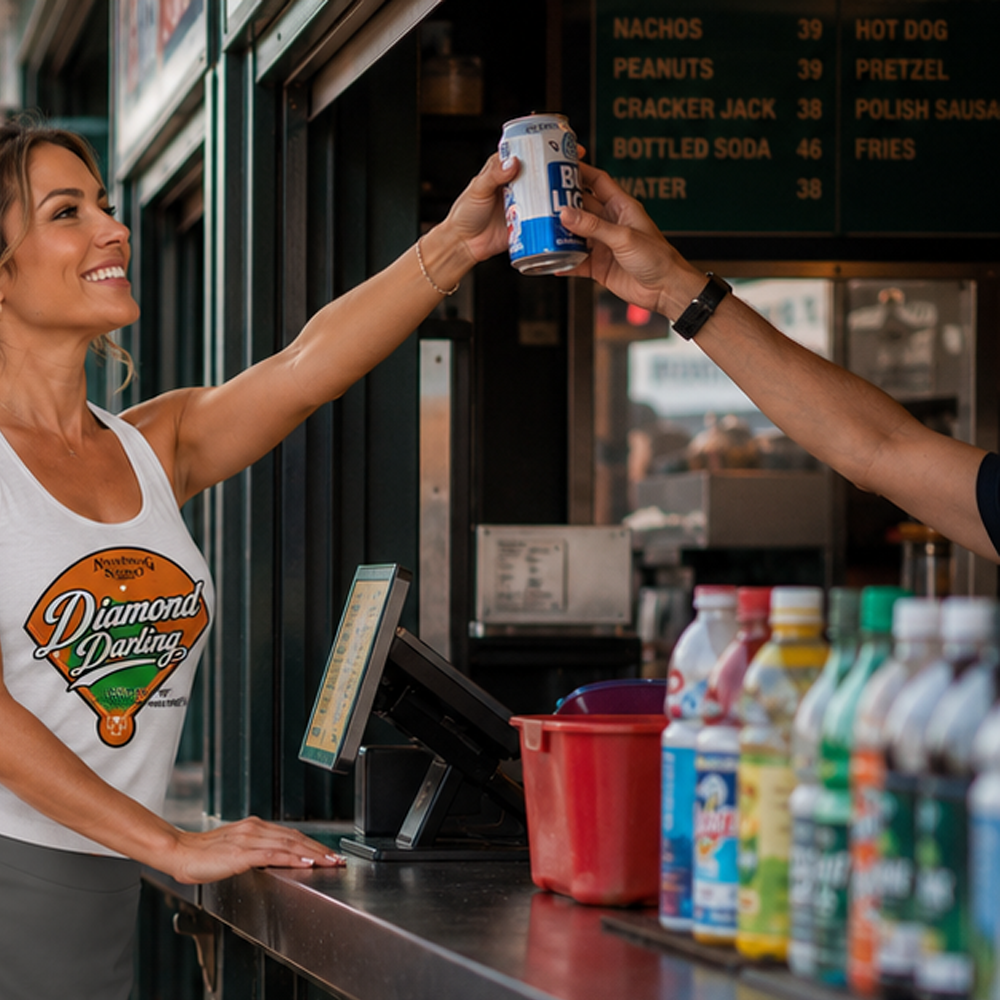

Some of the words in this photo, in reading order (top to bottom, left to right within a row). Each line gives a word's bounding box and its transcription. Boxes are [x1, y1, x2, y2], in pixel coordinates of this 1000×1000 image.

[613, 17, 703, 39] NACHOS
[797, 18, 823, 40] 39
[855, 18, 899, 41] HOT
[904, 18, 949, 41] DOG
[613, 57, 714, 79] PEANUTS
[797, 58, 823, 80] 39
[855, 58, 950, 81] PRETZEL
[613, 97, 715, 119] CRACKER
[719, 97, 777, 119] JACK
[796, 97, 823, 120] 38
[855, 98, 930, 120] POLISH
[613, 137, 709, 160] BOTTLED
[713, 137, 772, 160] SODA
[796, 137, 823, 160] 46
[855, 137, 917, 161] FRIES
[796, 177, 823, 200] 38
[33, 579, 205, 661] Diamond
[68, 625, 190, 679] Darling
